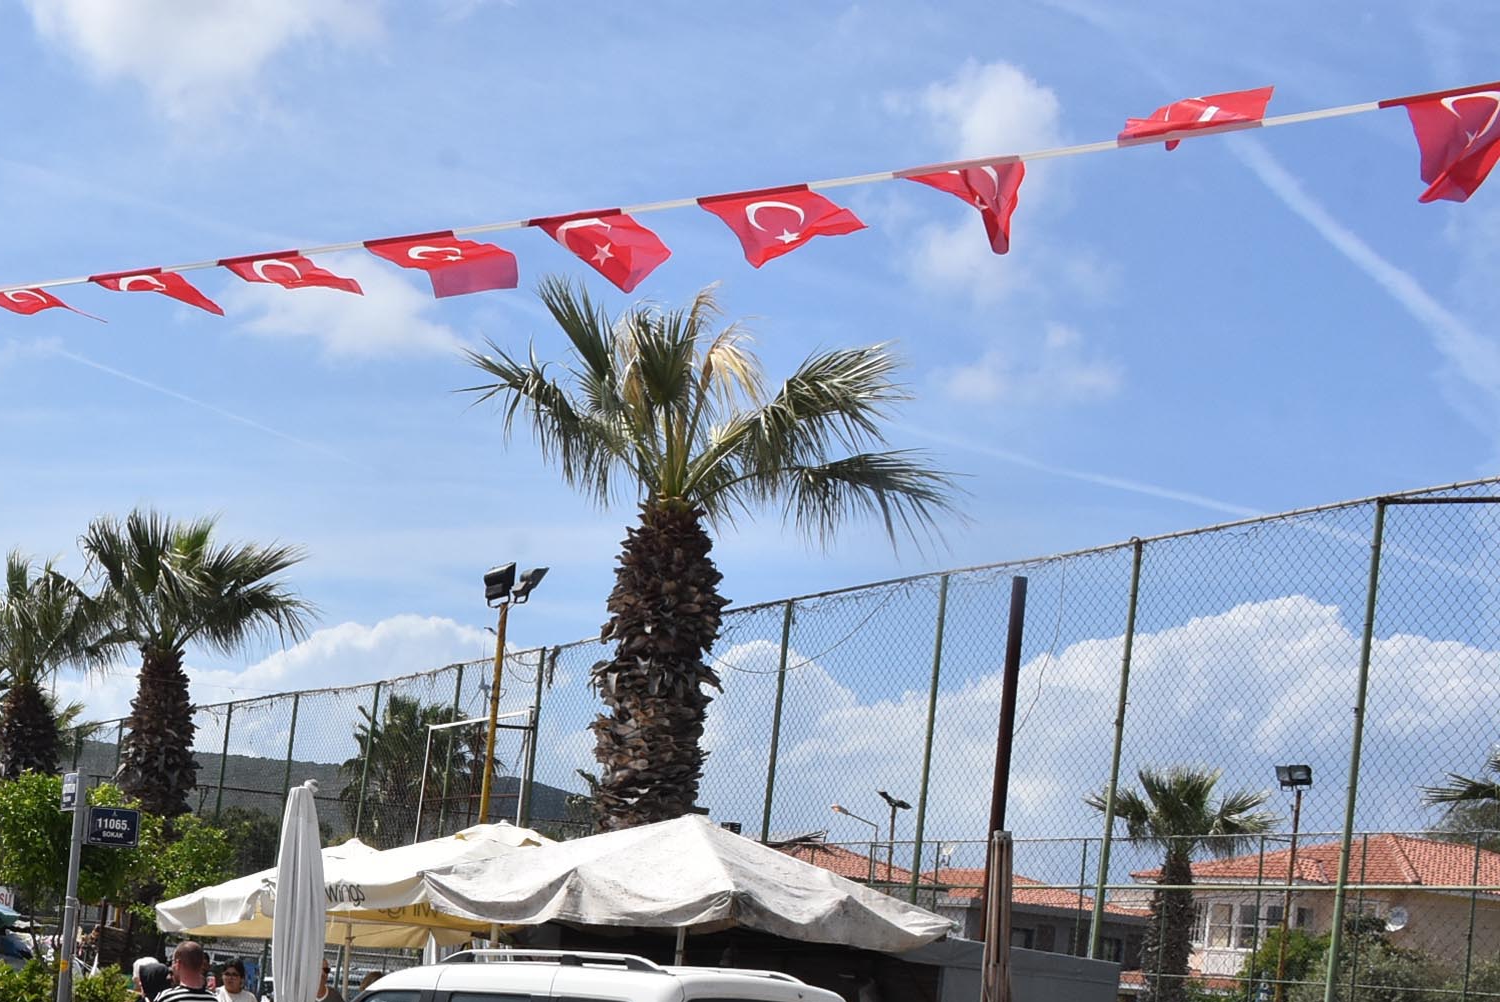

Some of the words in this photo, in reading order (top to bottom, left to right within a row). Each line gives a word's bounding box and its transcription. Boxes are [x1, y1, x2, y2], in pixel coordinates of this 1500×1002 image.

[96, 817, 131, 832] 11065.
[101, 830, 124, 839] SOKAK
[324, 883, 366, 907] wings
